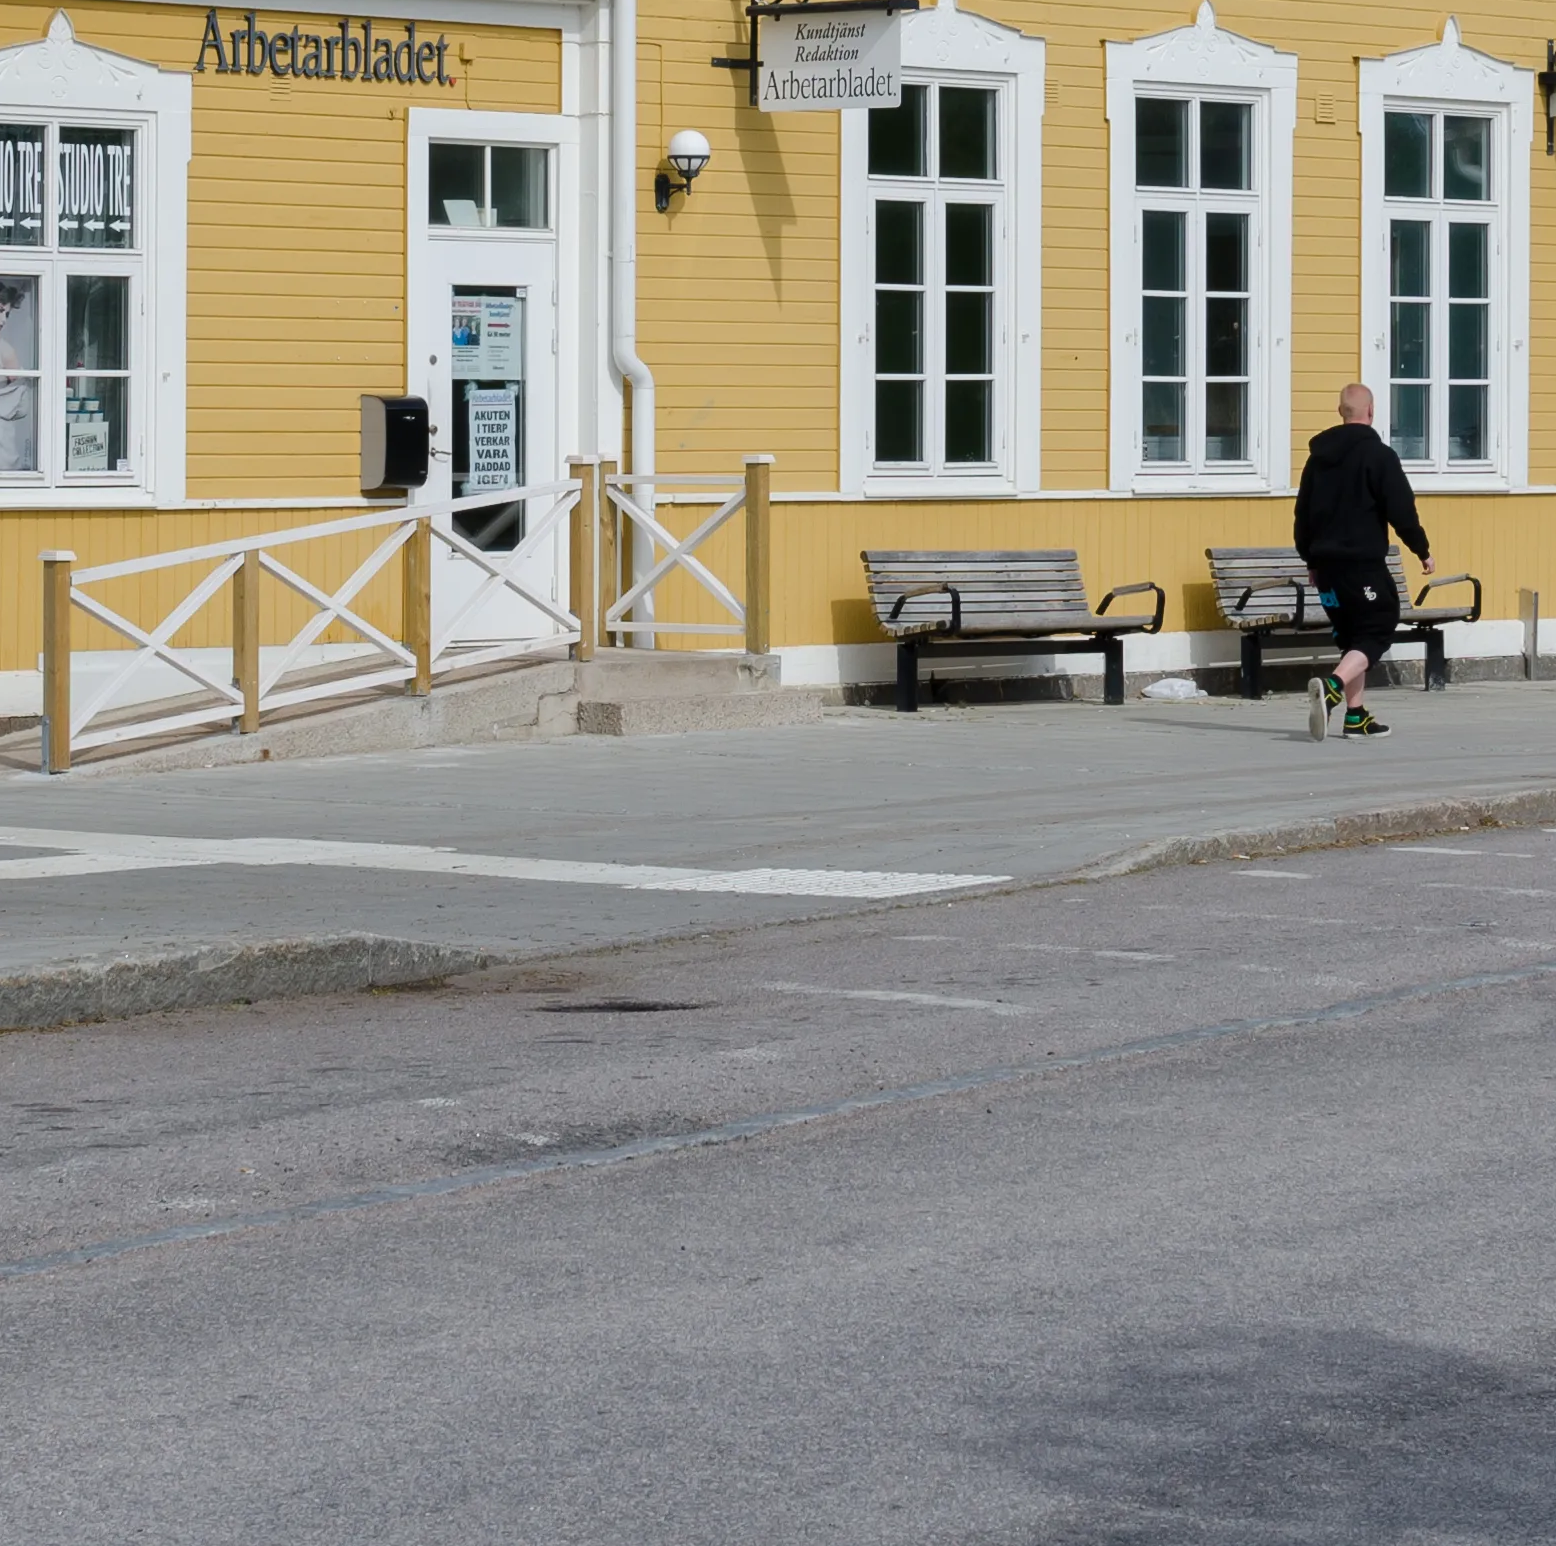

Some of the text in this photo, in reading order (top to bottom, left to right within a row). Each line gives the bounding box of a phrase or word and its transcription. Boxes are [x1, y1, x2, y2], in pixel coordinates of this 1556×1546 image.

[795, 22, 866, 43] Kundtjänst
[795, 44, 859, 62] Redaktion
[763, 66, 897, 100] Arbetarbladet.
[17, 141, 42, 214] TRE
[58, 142, 131, 216] STUDIO TRE
[474, 411, 510, 421] AKUTEN
[477, 424, 508, 433] I TIERP
[475, 436, 510, 446] VERKAR
[477, 449, 508, 459] VARA
